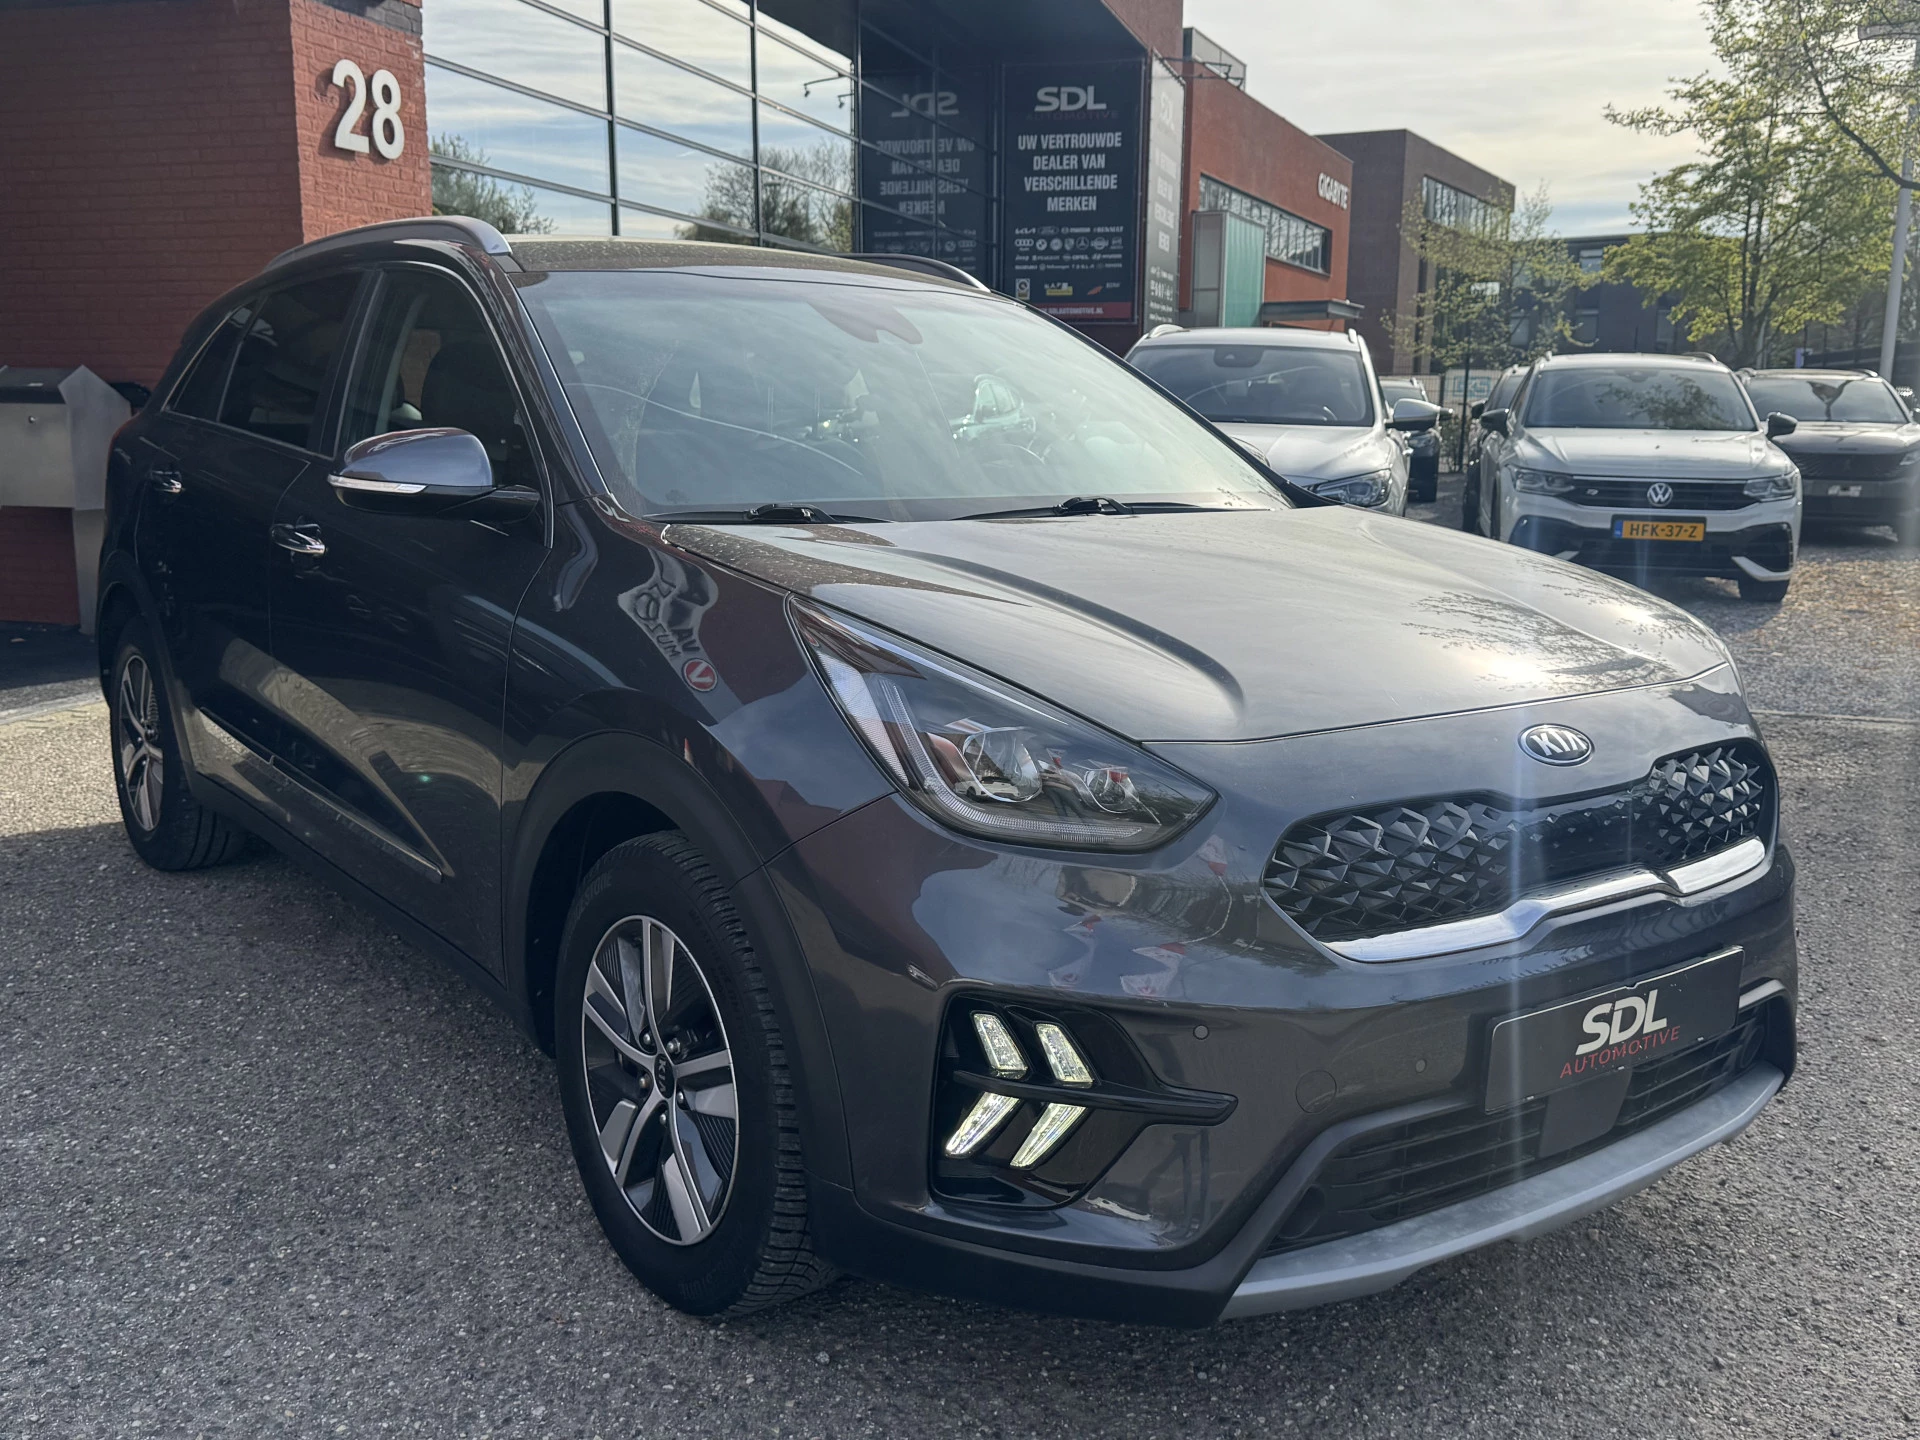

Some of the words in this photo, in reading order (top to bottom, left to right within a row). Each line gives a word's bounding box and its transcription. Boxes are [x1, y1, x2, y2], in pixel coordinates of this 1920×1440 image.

[332, 58, 405, 160] 28
[1034, 85, 1107, 112] SDL
[1017, 134, 1038, 151] UW
[1041, 131, 1122, 150] VERTROUWDE
[1033, 154, 1079, 171] DEALER
[1081, 153, 1106, 169] VAN
[1023, 174, 1118, 192] VERSCHILLENDE
[1046, 195, 1097, 212] MERKEN
[1629, 523, 1699, 539] HFK-37-Z
[1527, 727, 1589, 757] KIA
[1575, 989, 1668, 1056] SDL
[1559, 1025, 1681, 1079] AUTOMOTIVE
